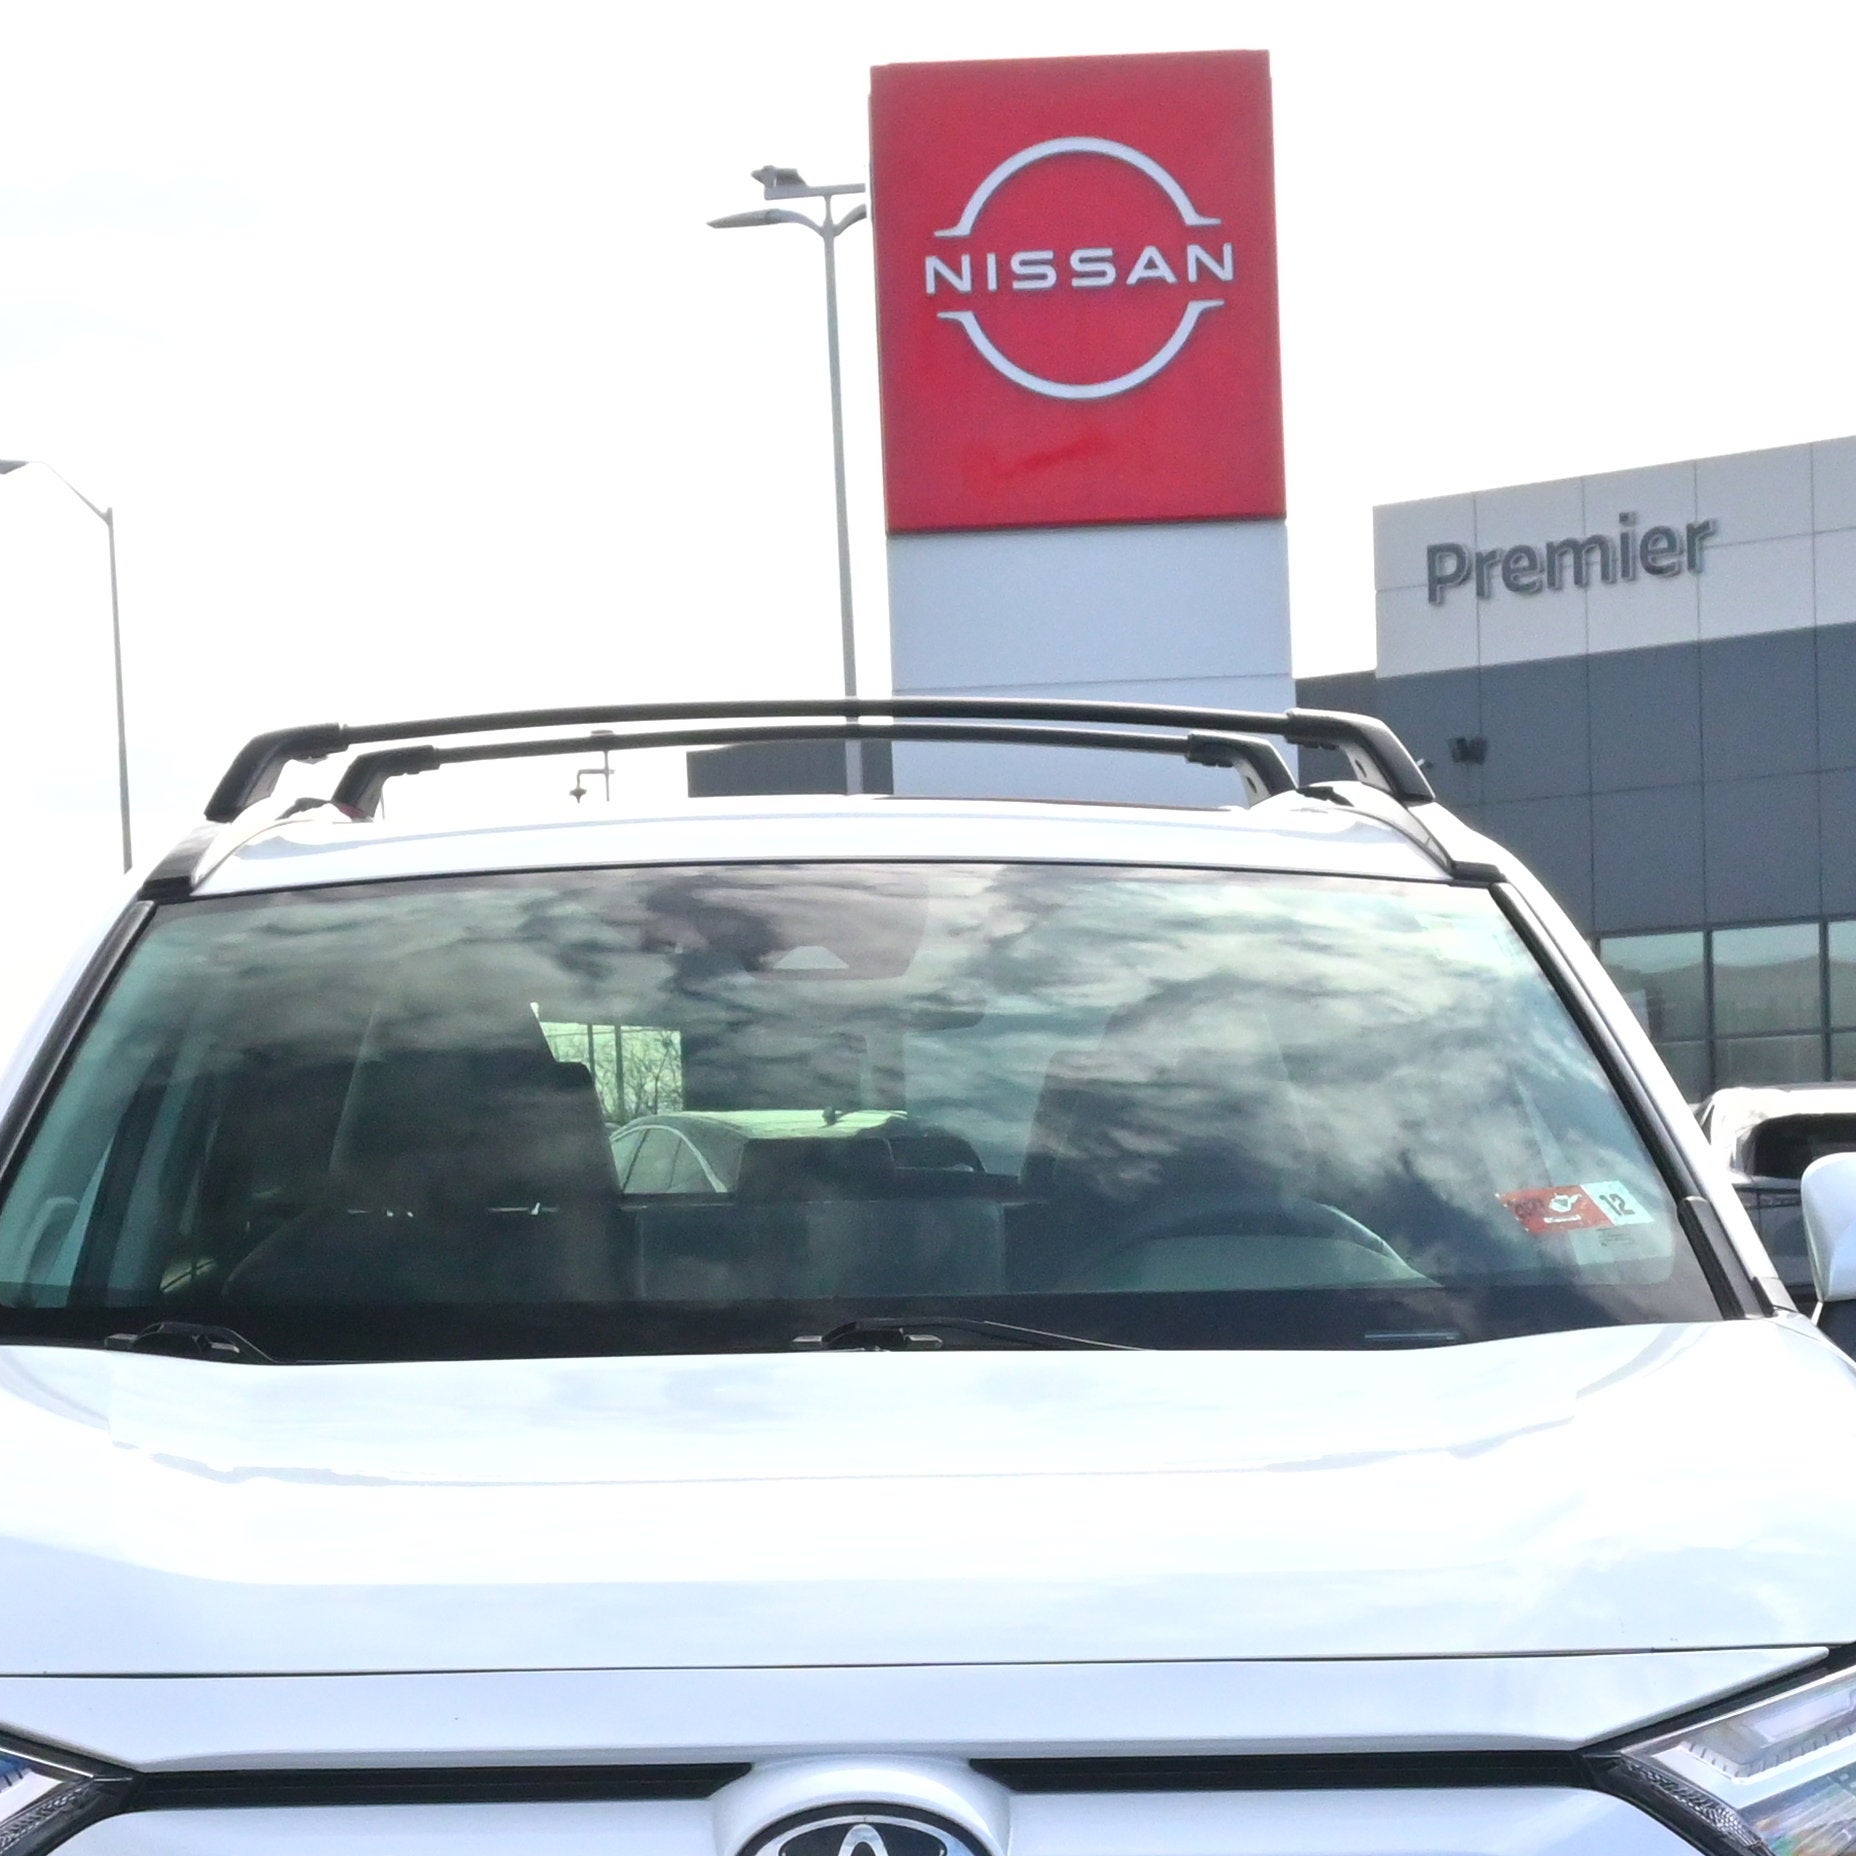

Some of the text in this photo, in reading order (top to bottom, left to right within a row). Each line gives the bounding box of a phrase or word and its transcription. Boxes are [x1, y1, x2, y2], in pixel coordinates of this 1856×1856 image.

[925, 243, 1234, 295] NISSAN
[1426, 510, 1718, 606] Premier
[1599, 1193, 1635, 1216] 12
